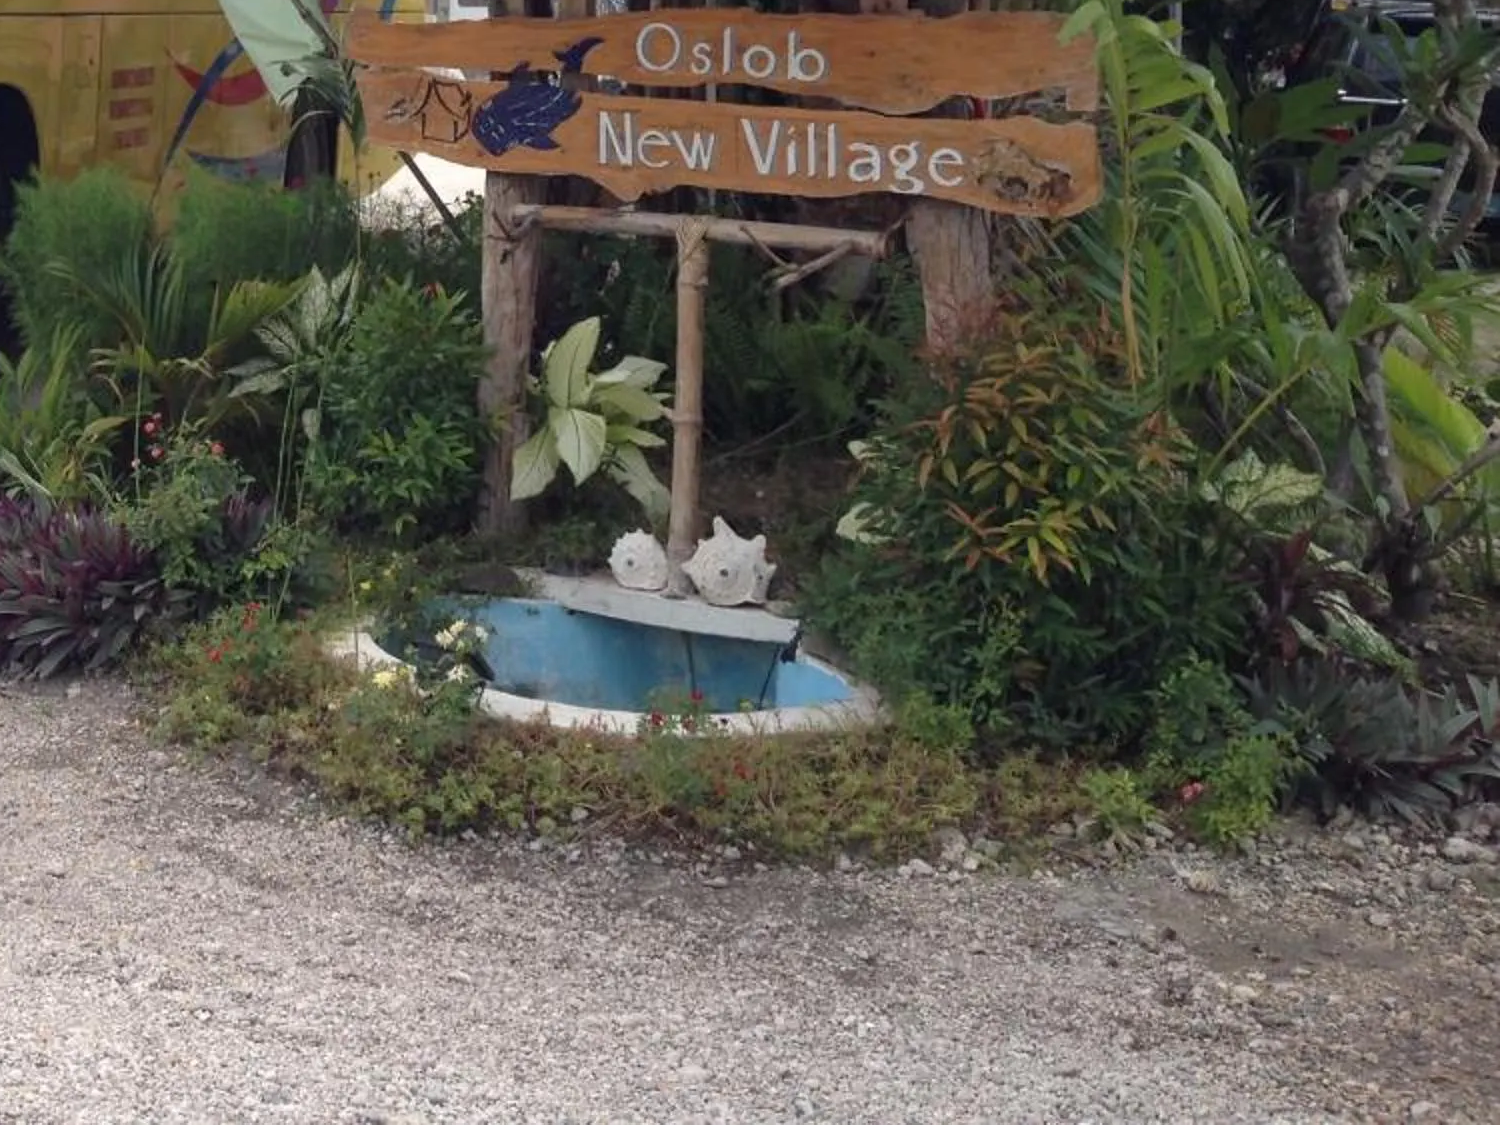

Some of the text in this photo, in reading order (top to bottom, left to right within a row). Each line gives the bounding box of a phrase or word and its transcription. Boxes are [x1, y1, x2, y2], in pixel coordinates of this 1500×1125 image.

[636, 22, 825, 81] Oslob
[598, 112, 964, 194] New Village
